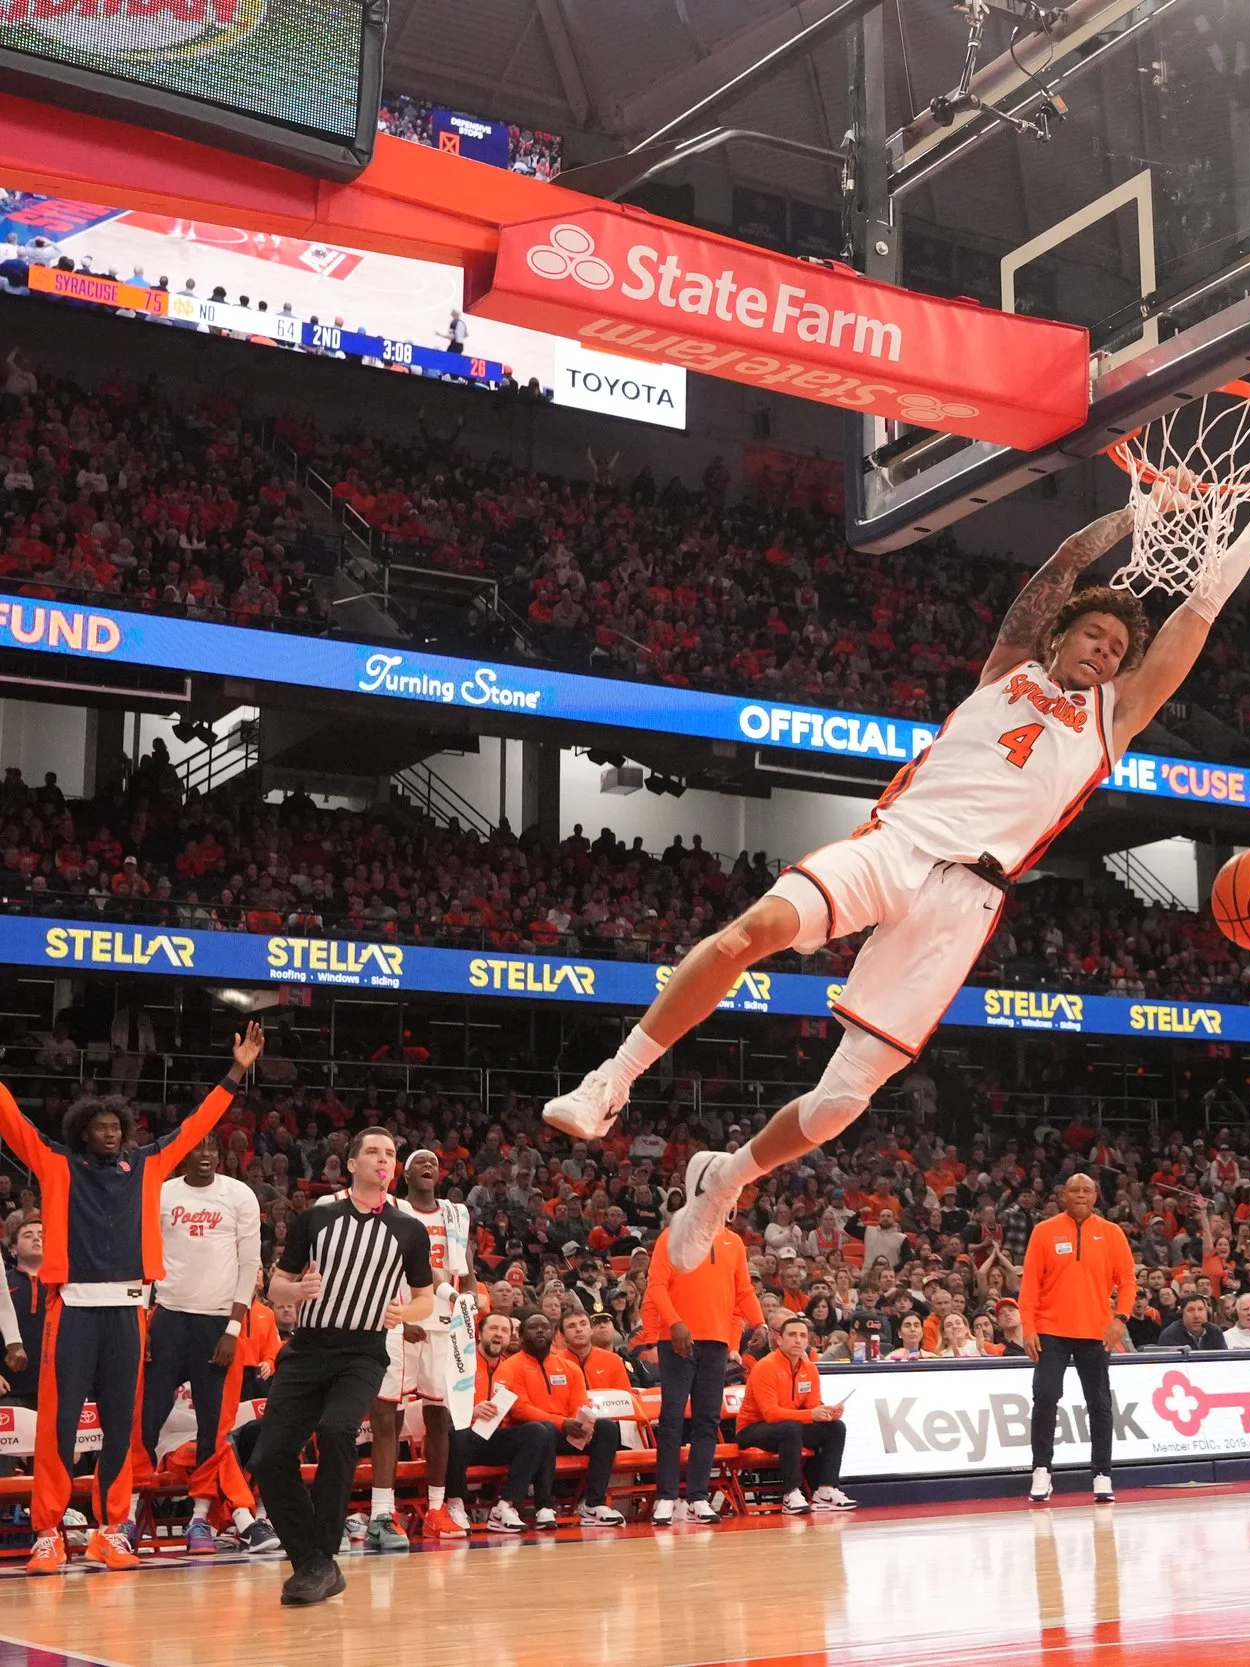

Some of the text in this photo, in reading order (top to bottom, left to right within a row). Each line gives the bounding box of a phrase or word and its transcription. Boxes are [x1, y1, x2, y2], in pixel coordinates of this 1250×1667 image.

[450, 116, 492, 134] DEFENSIVE
[458, 125, 483, 140] STOPS
[55, 273, 162, 313] SYRACUSE 75
[199, 303, 215, 322] ND
[277, 318, 295, 339] 64
[313, 324, 486, 378] 2ND 3:08 26
[565, 367, 675, 409] TOYOTA
[359, 653, 541, 709] Turning Stone
[1001, 673, 1088, 734] Syracuse
[739, 703, 907, 758] OFFICIAL
[997, 722, 1045, 769] 4
[45, 927, 195, 968] STELLAR
[267, 936, 403, 975] STELLAR
[270, 969, 400, 988] Roofing Windows Siding
[469, 958, 595, 995] STELLAR
[743, 1000, 768, 1012] Siding
[984, 989, 1083, 1020] STELLAR
[1129, 1004, 1222, 1034] STELLAR
[171, 1205, 223, 1229] Poetry
[189, 1224, 204, 1237] 21
[601, 1399, 630, 1408] TOYOTA
[75, 1433, 102, 1444] TOYOT
